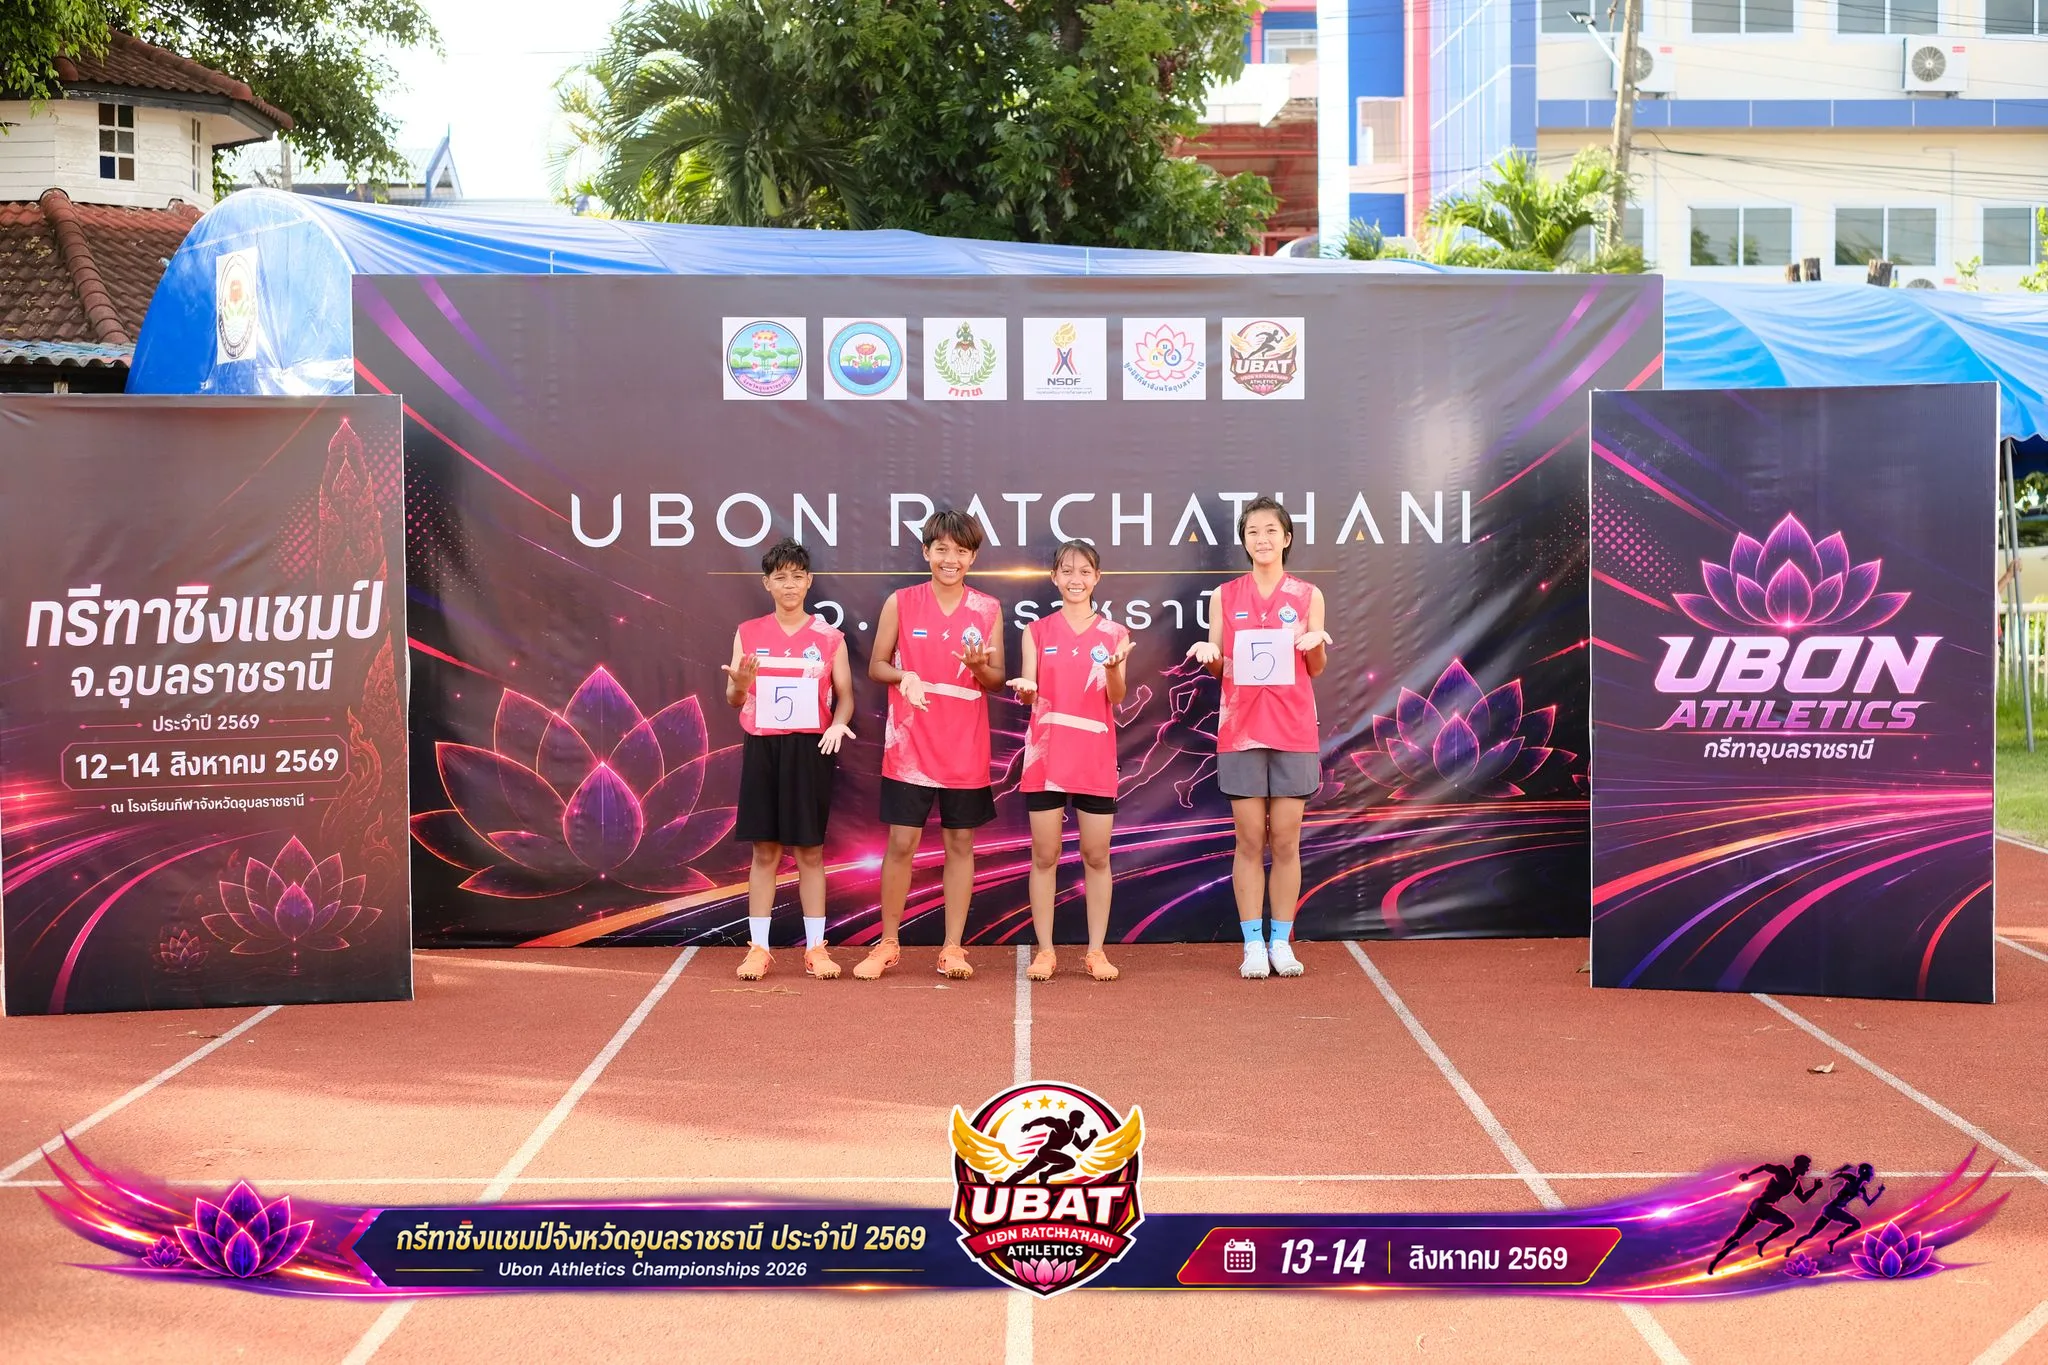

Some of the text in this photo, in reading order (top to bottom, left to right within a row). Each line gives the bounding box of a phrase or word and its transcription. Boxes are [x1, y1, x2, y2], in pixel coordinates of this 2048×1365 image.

[1235, 359, 1292, 374] UBAT
[1047, 378, 1081, 386] NSDF
[571, 493, 837, 547] UBON
[26, 580, 384, 647] กรีฑาชิงแชมป์
[1251, 642, 1276, 681] 5
[1654, 636, 1944, 694] UBON
[71, 648, 334, 708] จ.อุบลราชธานี
[774, 686, 798, 722] 5
[1653, 700, 1935, 730] ATHLETICS
[152, 713, 260, 732] ประจำปี 2569
[170, 750, 266, 777] สิงหาคม
[275, 748, 339, 774] 2569
[1703, 736, 1875, 764] กรีฑาอุบลราชธานี
[111, 793, 305, 813] ณ โรงเรียนกีฬาจังหวัดอุบลราชธานี
